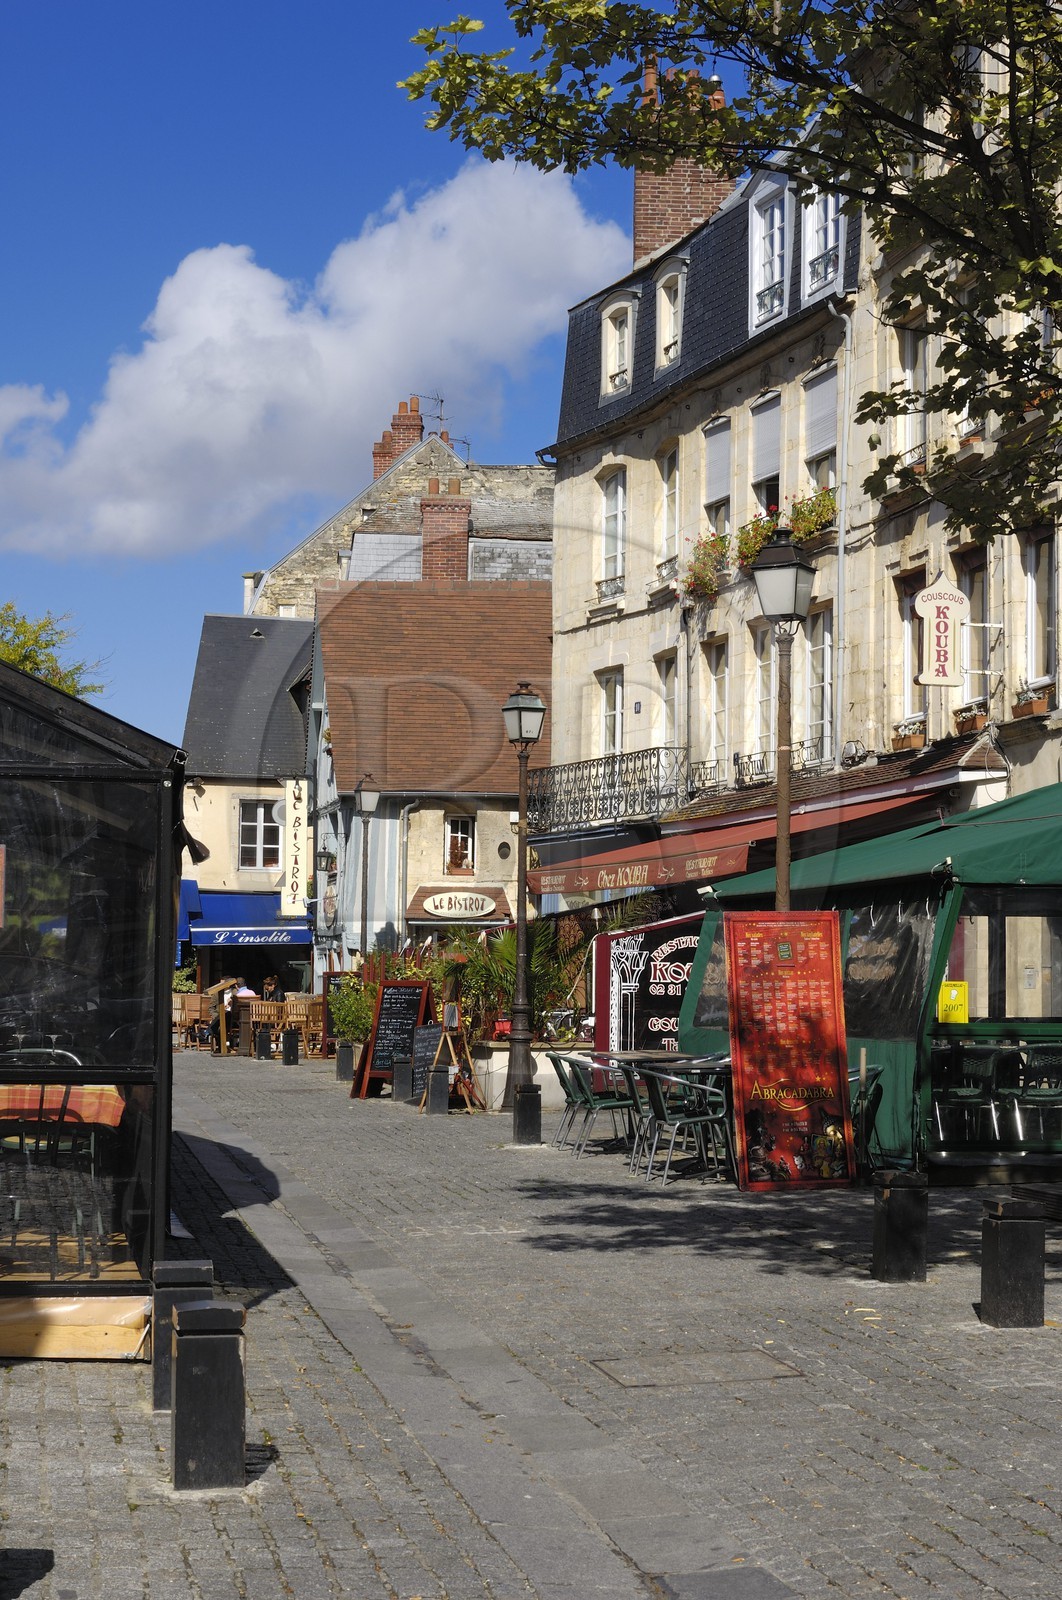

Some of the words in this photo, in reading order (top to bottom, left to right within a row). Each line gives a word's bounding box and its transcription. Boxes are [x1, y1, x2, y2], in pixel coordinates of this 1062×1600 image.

[921, 592, 965, 605] COUSCOUS
[934, 605, 950, 678] KOUBA
[685, 856, 718, 870] RESTAURANT
[597, 870, 616, 889] Chez
[616, 864, 649, 887] KOUBA
[432, 897, 445, 910] LE
[649, 984, 665, 995] 02
[667, 984, 682, 995] 31
[944, 1003, 963, 1012] 2007
[750, 1080, 834, 1101] ABRACADABRA
